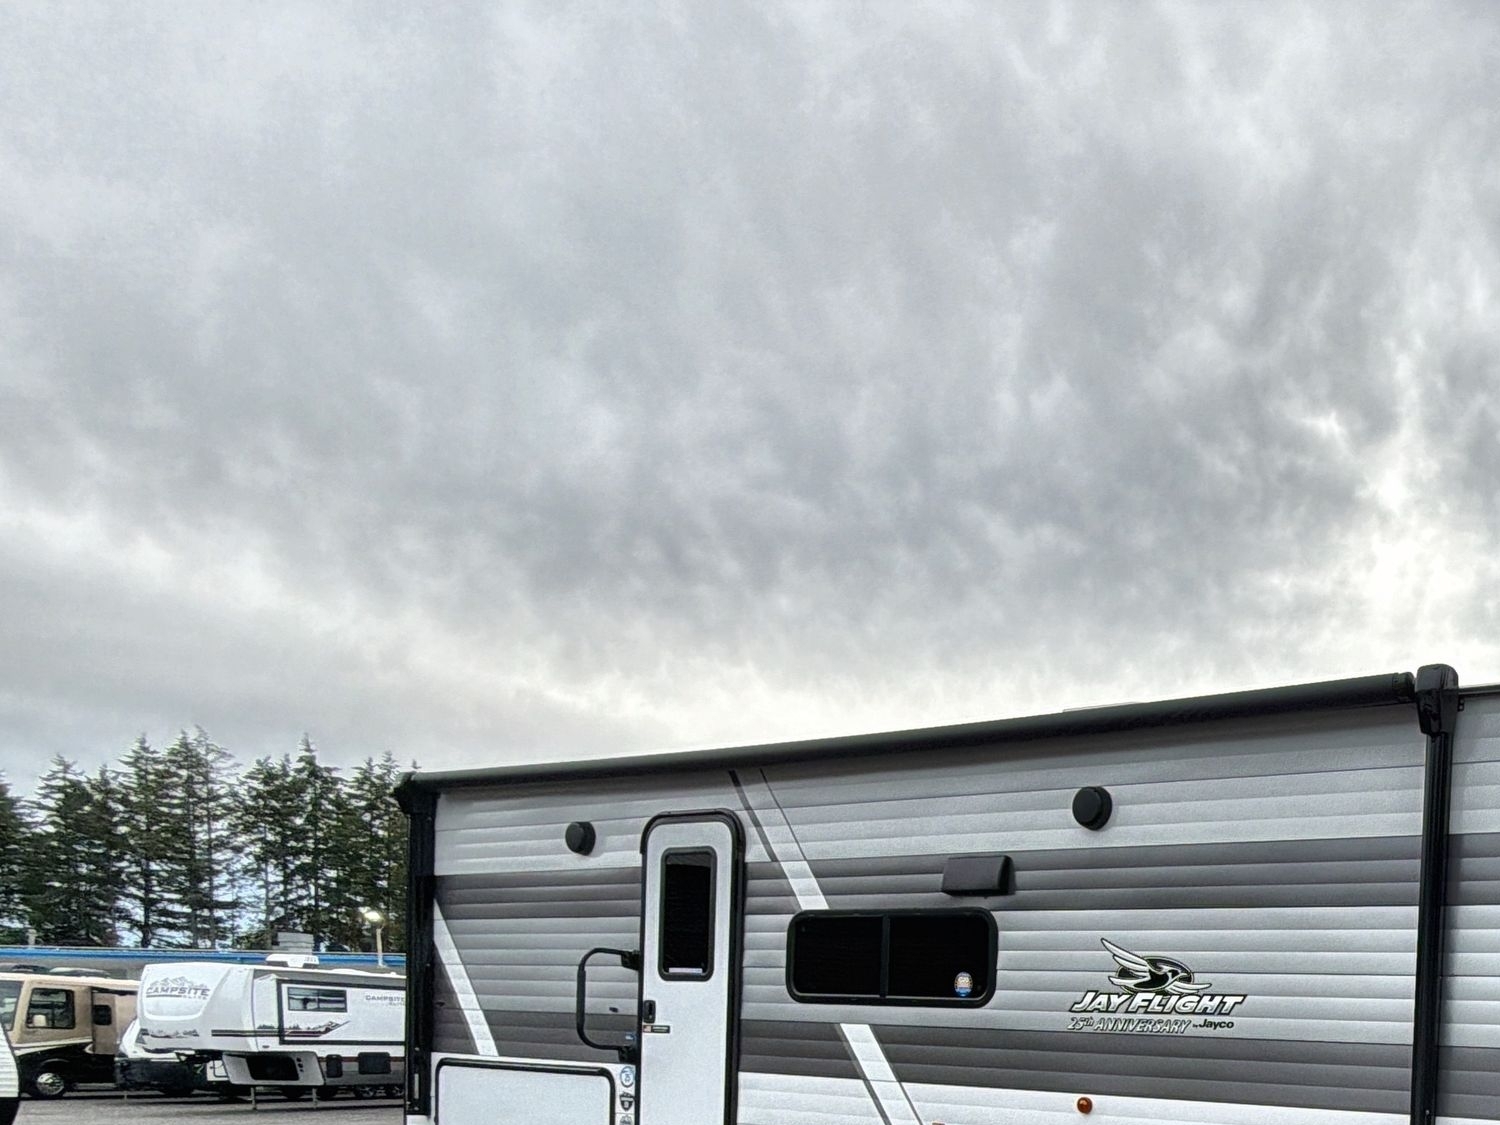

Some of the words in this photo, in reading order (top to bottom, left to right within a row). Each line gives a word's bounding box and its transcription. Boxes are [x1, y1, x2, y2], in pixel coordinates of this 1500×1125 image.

[146, 986, 210, 997] CAMPSITE
[1069, 990, 1134, 1013] JAY
[1125, 992, 1247, 1015] FLIGHT
[1067, 1016, 1094, 1030] 25th
[1094, 1018, 1191, 1034] ANNIVERSARY
[1198, 1019, 1234, 1031] Jayco
